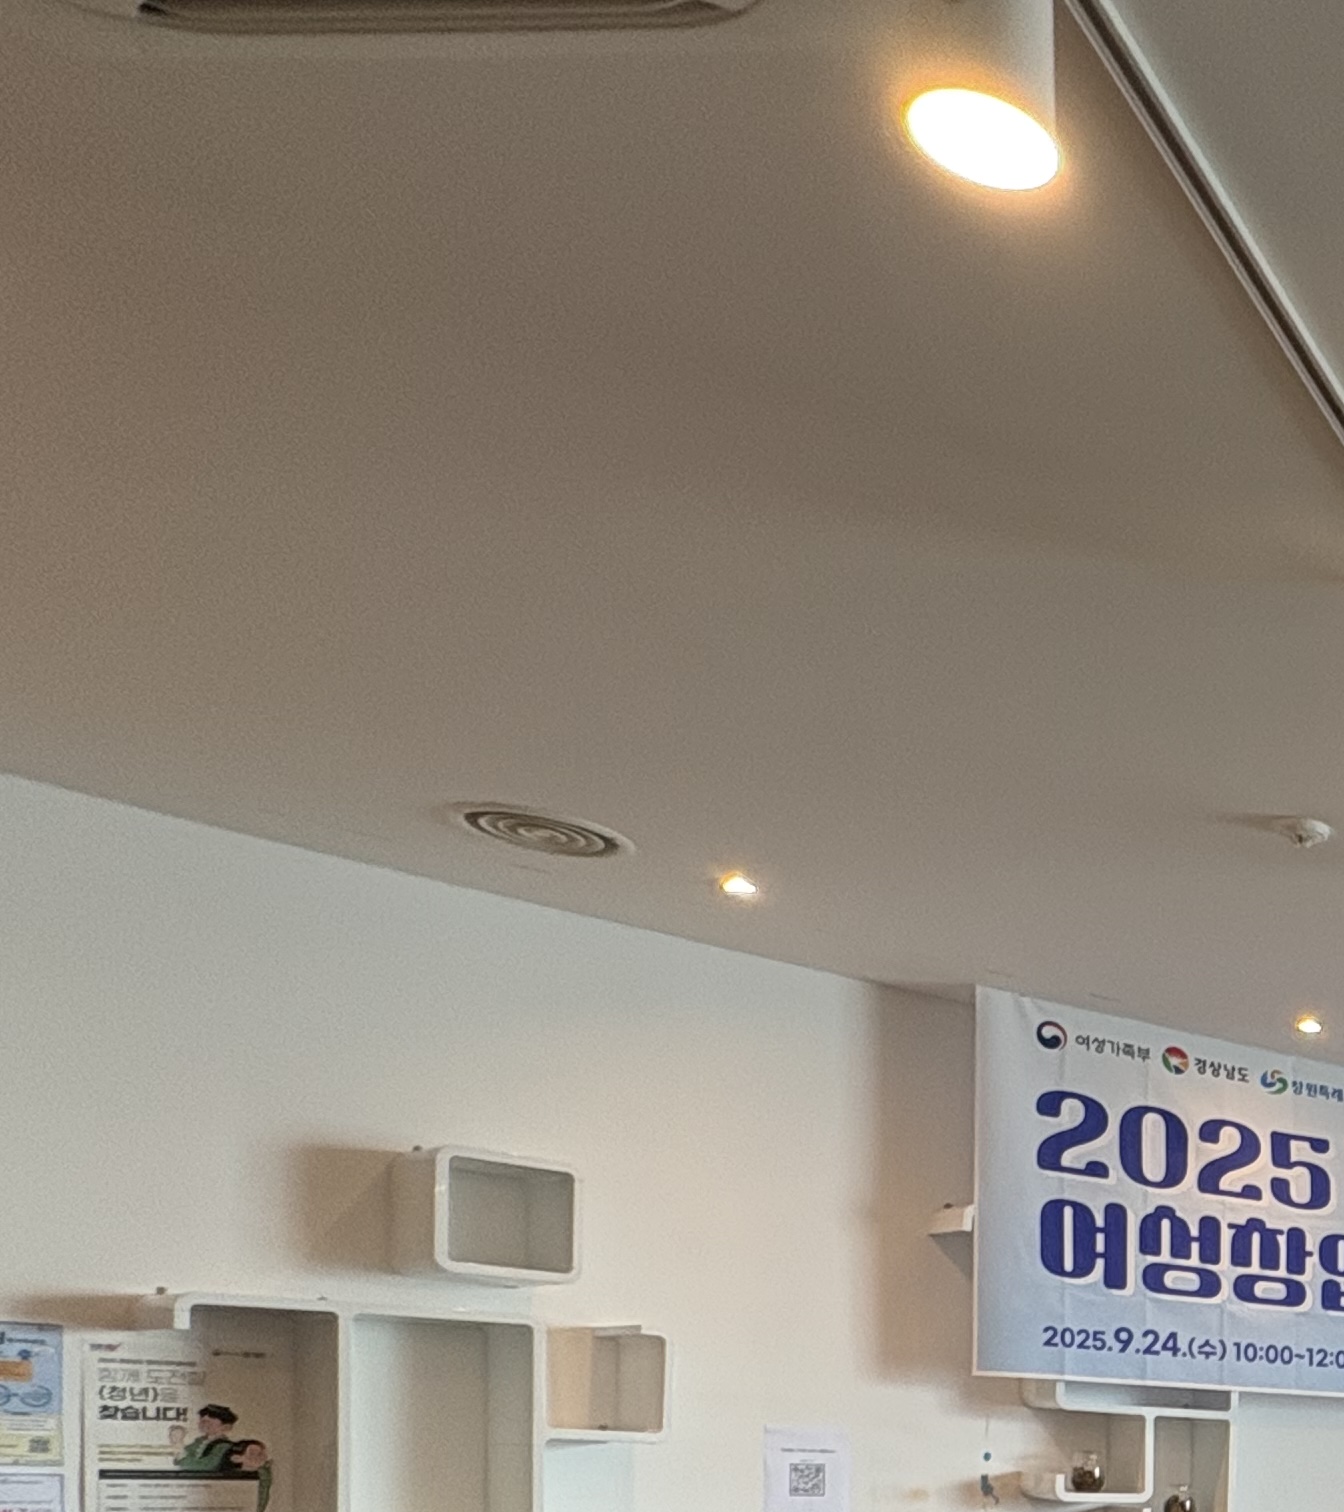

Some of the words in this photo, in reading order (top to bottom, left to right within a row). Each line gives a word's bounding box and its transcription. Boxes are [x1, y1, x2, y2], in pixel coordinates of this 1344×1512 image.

[1075, 1034, 1151, 1062] 여성가족부
[1194, 1057, 1250, 1083] 경상남도
[1035, 1089, 1332, 1210] 2025
[1042, 1325, 1227, 1361] 2025.9.24.(수)
